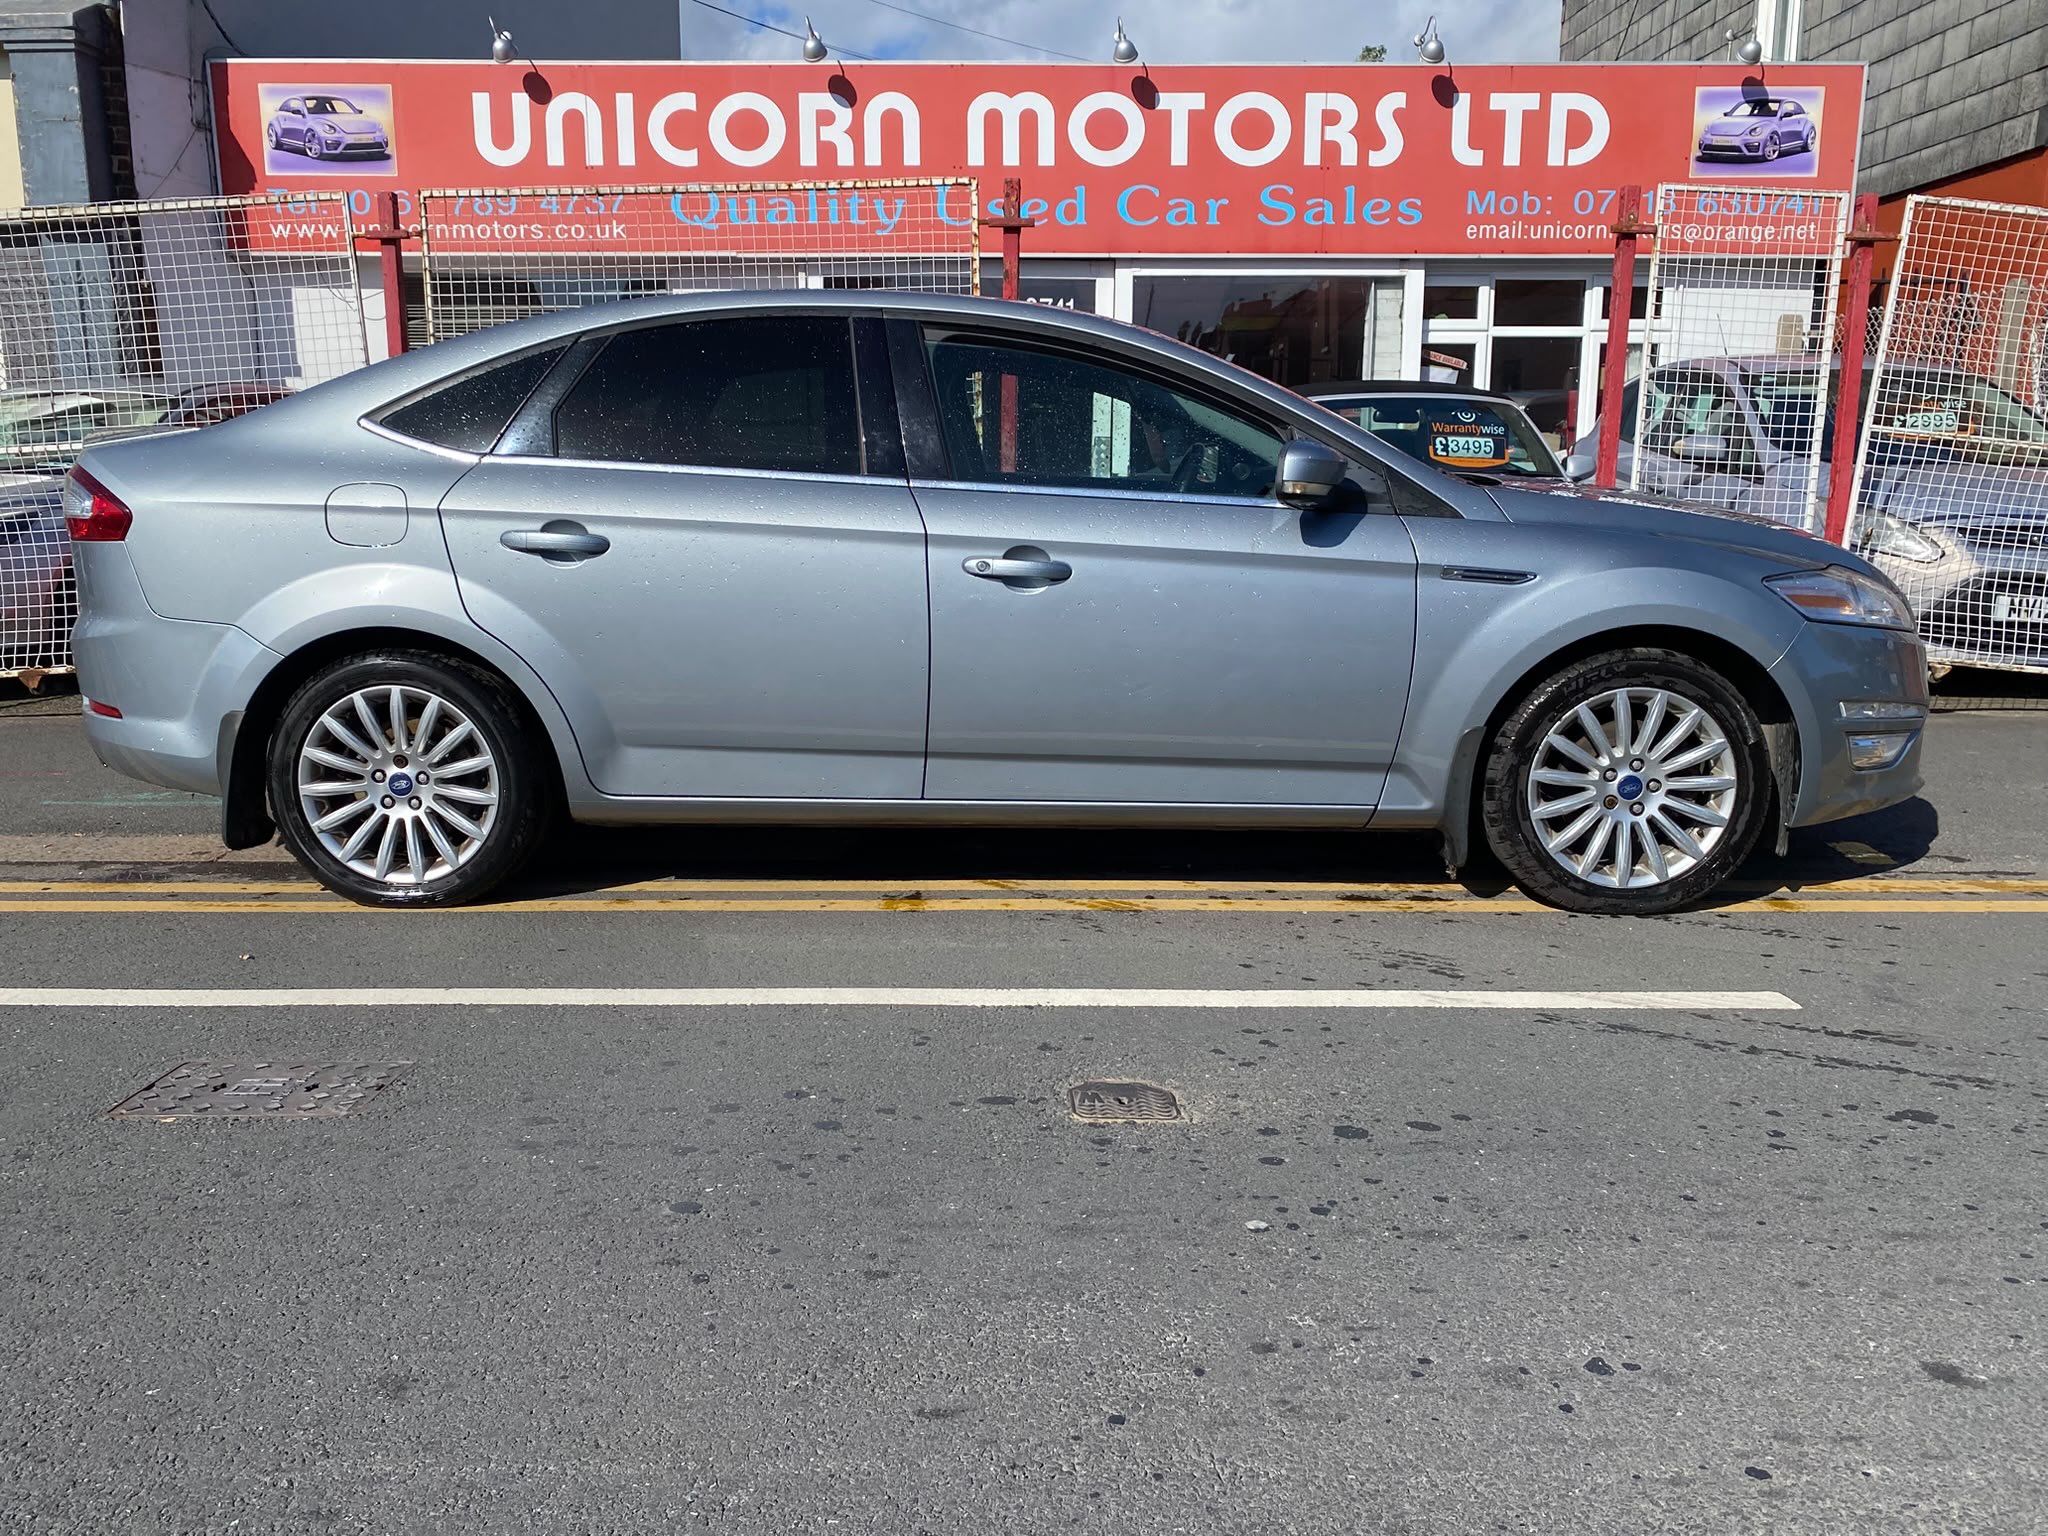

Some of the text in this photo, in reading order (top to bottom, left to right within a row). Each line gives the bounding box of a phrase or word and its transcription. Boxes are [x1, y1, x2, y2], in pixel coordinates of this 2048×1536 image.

[471, 91, 1612, 167] UNICORN MOTORS LTD
[670, 186, 906, 236] Quality
[1116, 184, 1229, 226] Car
[1257, 184, 1423, 226] Sales
[1466, 190, 1821, 216] Mob: 0713 630741
[1431, 422, 1505, 436] Warrantywise
[1434, 437, 1493, 456] £3495
